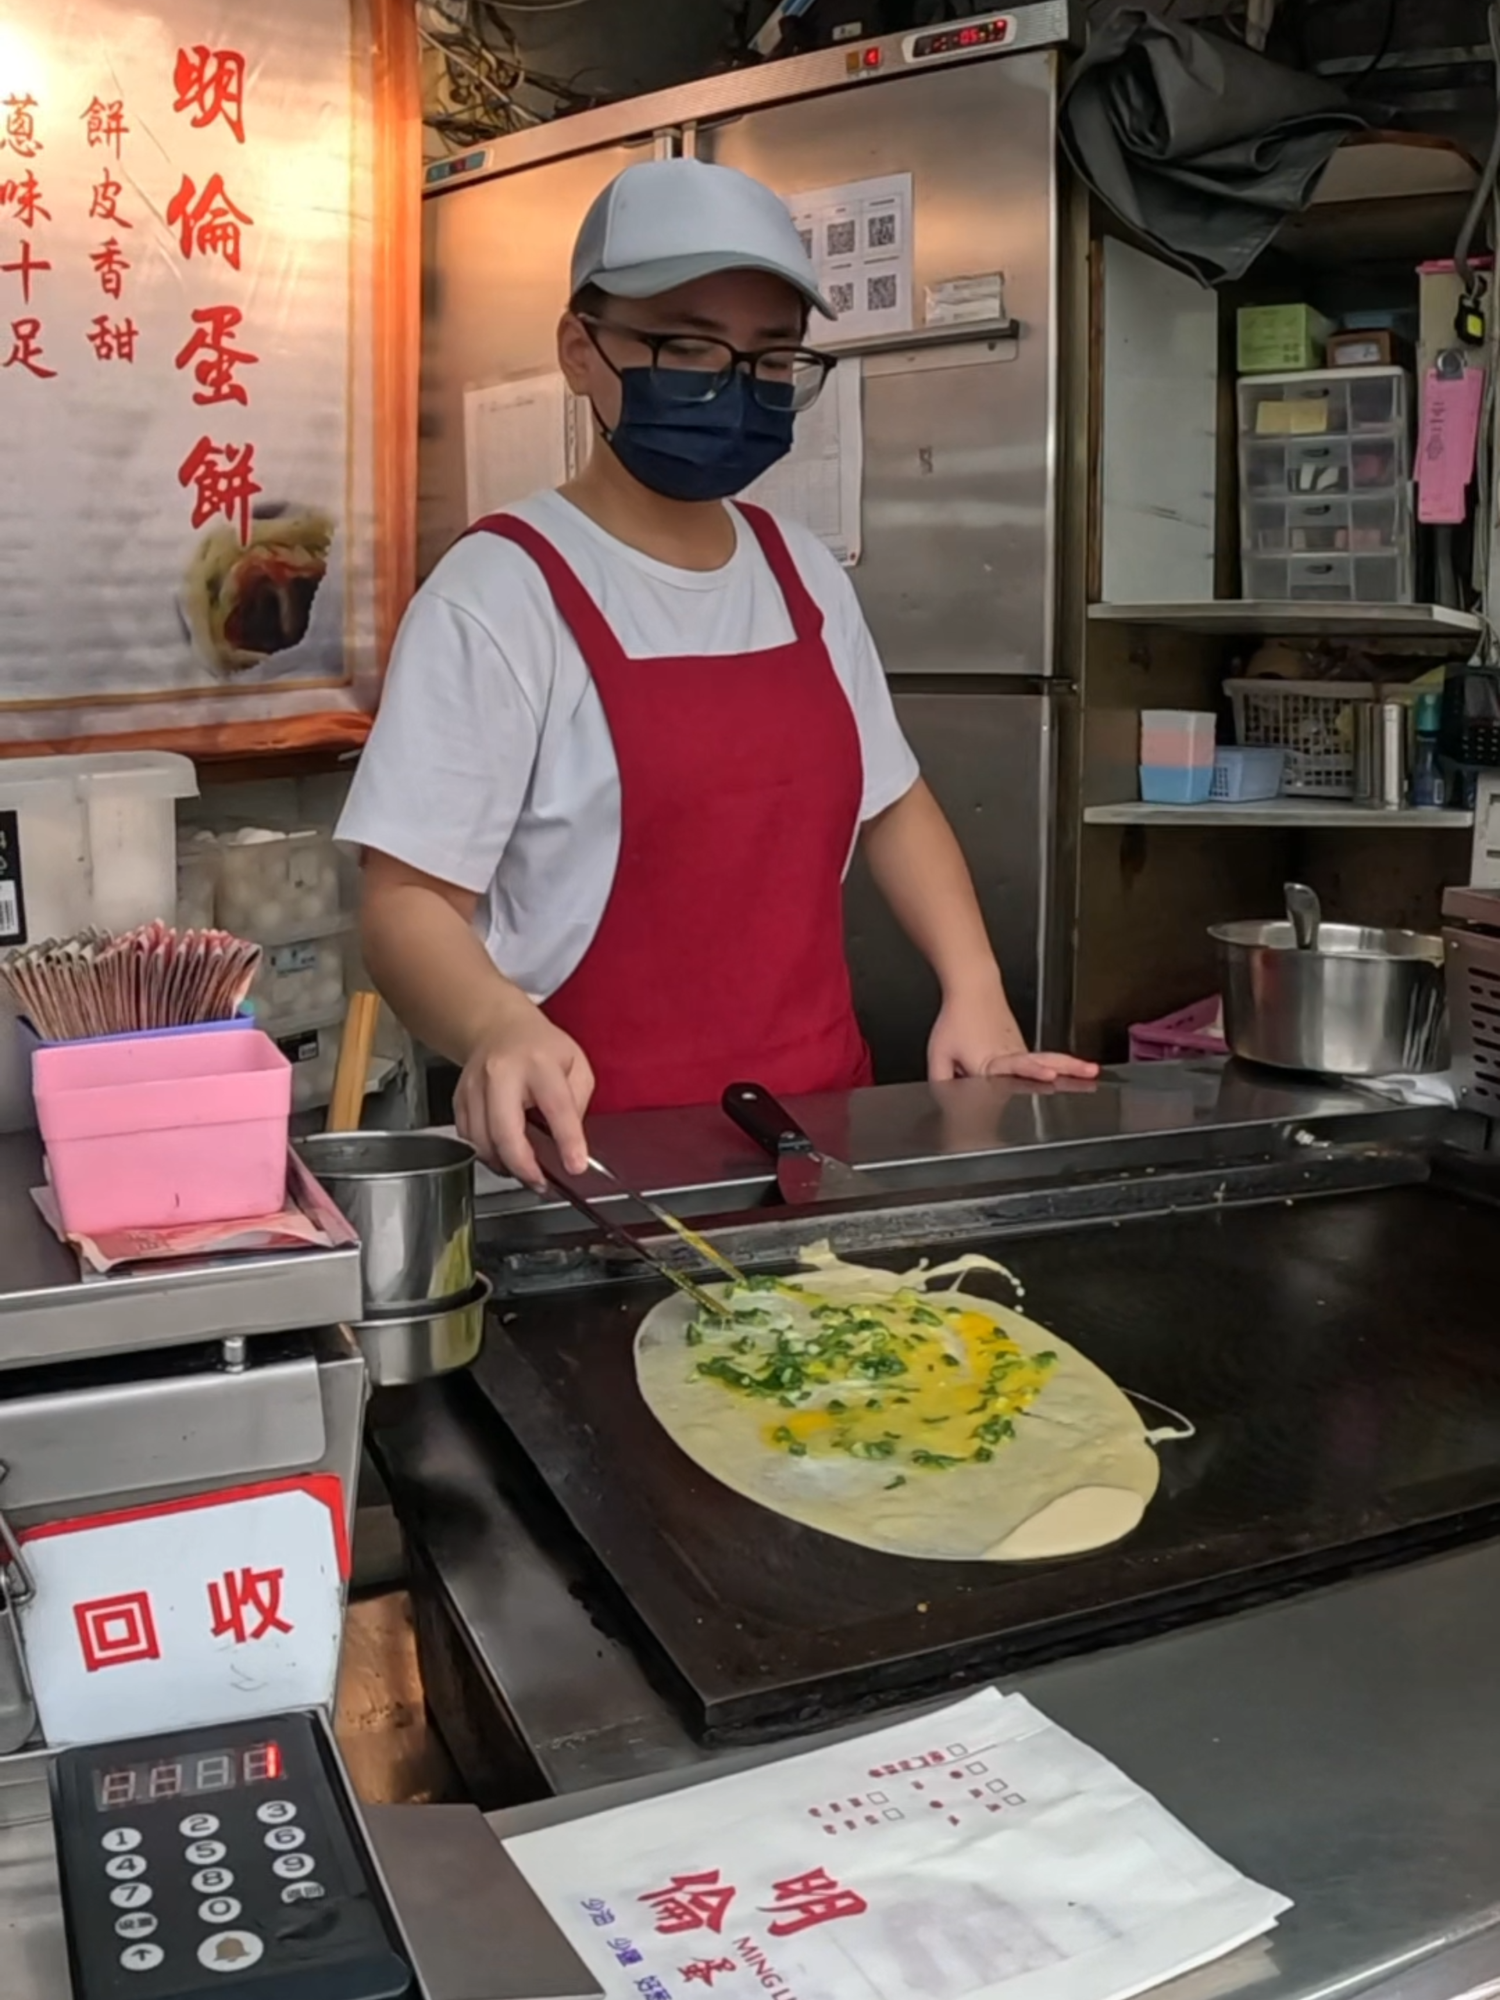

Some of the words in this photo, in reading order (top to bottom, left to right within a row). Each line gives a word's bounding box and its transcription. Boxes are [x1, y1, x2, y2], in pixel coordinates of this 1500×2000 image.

[79, 95, 139, 364] 餅皮香甜
[166, 45, 262, 547] 明倫蛋餅
[73, 1567, 294, 1673] 回收
[115, 1831, 128, 1846] 1
[189, 1816, 211, 1832] 2
[267, 1803, 288, 1818] 3
[115, 1857, 137, 1872] 4
[195, 1843, 217, 1858] 5
[275, 1829, 297, 1844] 6
[119, 1885, 140, 1902] 7
[201, 1871, 224, 1887] 8
[282, 1855, 306, 1872] 9
[637, 1866, 868, 1937] 明倫
[208, 1899, 232, 1916] 0
[732, 1936, 783, 1989] MING
